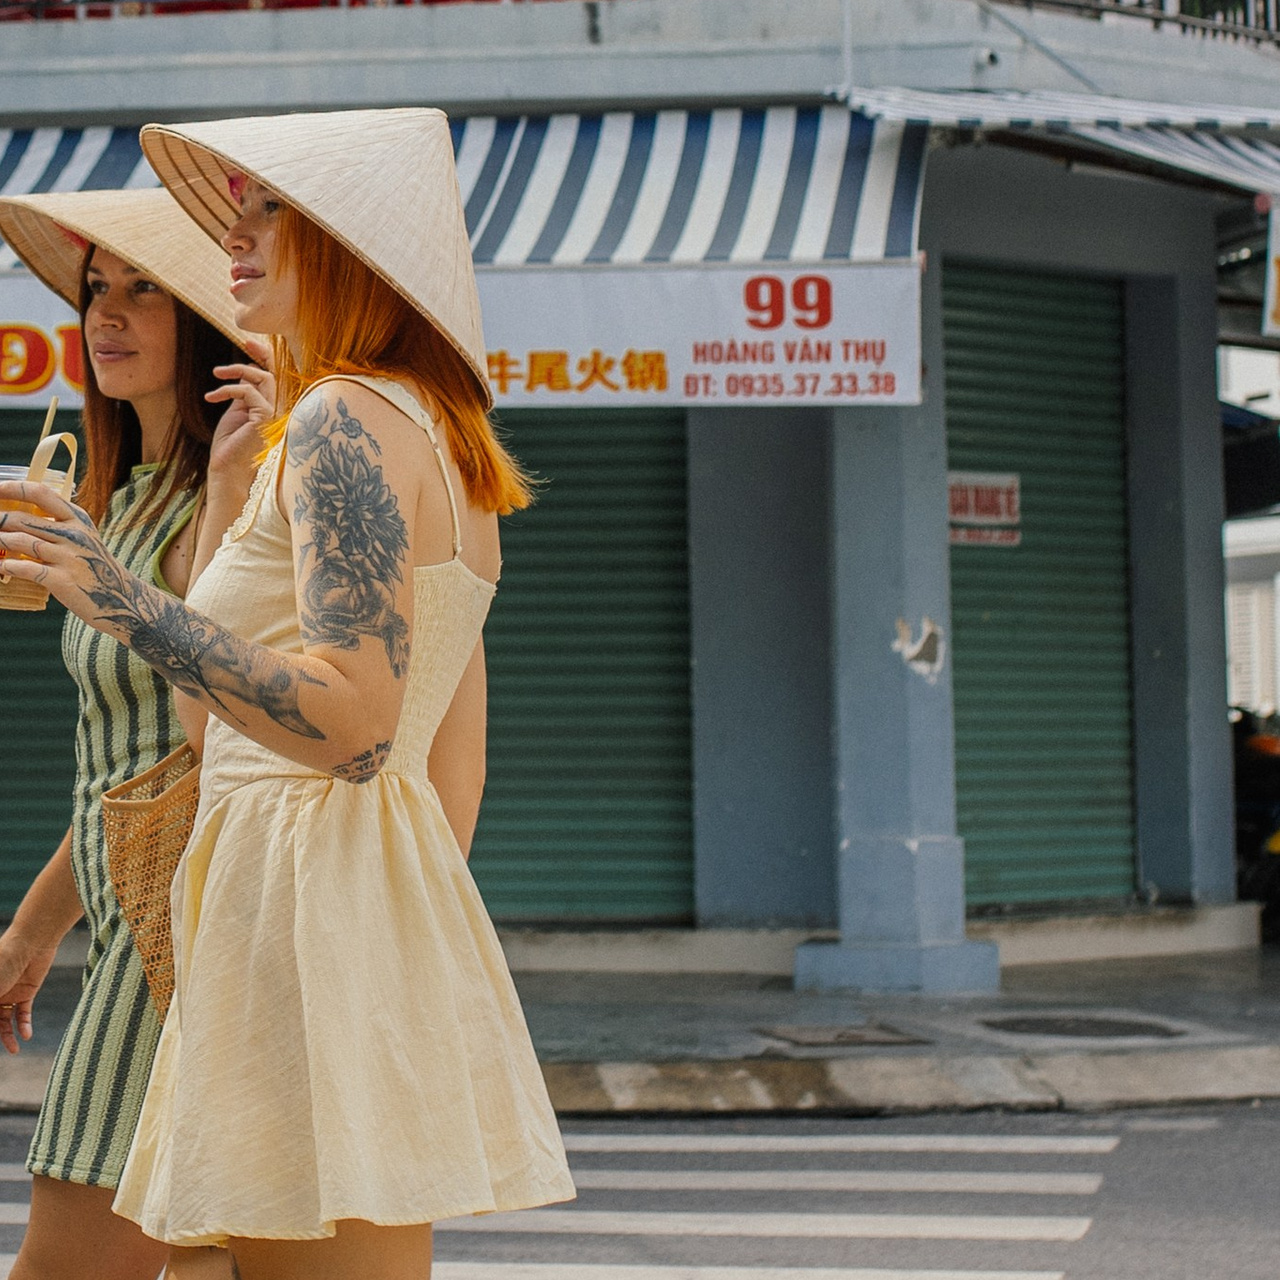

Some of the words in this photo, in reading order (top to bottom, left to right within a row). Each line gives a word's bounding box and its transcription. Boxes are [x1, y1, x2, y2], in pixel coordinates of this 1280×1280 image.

[742, 274, 834, 332] 99
[692, 335, 775, 365] HOÀNG
[841, 338, 887, 368] THỤ
[724, 371, 897, 397] 0935.37.33.38
